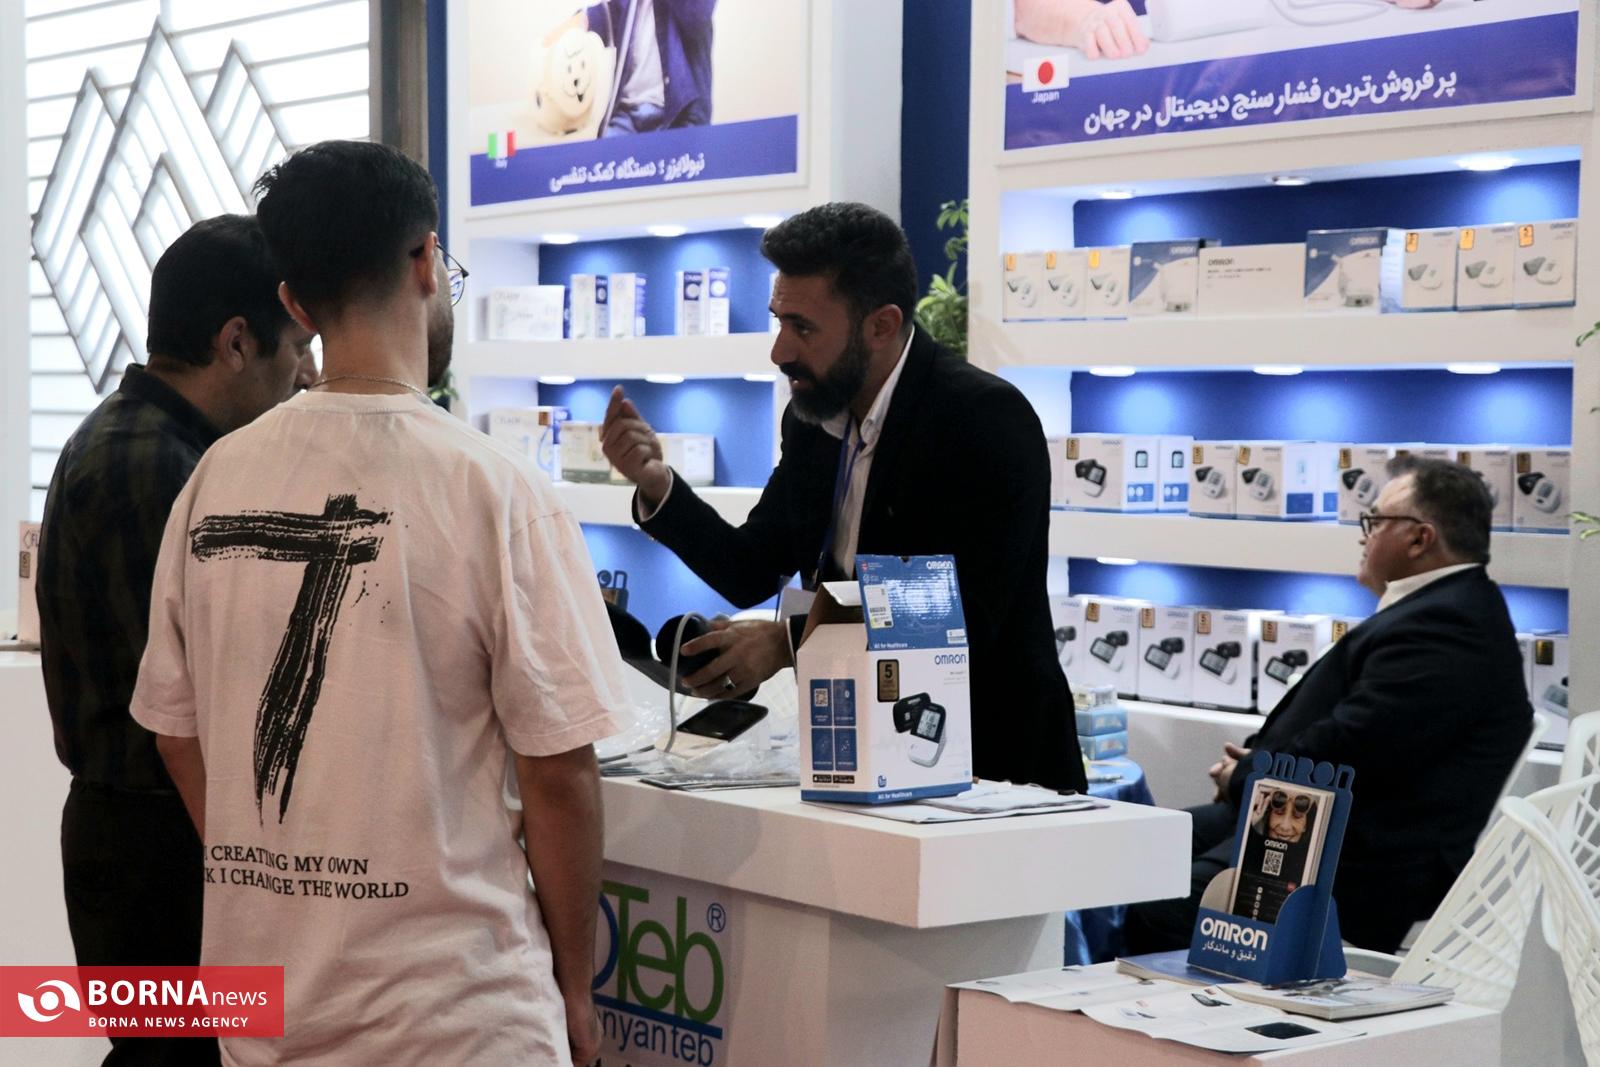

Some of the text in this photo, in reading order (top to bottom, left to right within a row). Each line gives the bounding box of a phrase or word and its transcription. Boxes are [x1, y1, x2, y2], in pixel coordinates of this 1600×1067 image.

[1031, 91, 1060, 104] Japan
[1155, 94, 1230, 127] دیجیتال
[1231, 89, 1275, 121] سنج
[1273, 77, 1321, 116] فشار
[1083, 103, 1131, 135] جهان
[1131, 103, 1153, 130] در
[884, 664, 893, 679] 5
[934, 653, 967, 666] OMRON
[1253, 750, 1356, 791] OMRON
[211, 845, 289, 872] CREATING
[294, 855, 325, 873] MY
[328, 856, 369, 876] OWN
[1264, 839, 1288, 851] OMRON
[220, 867, 227, 884] I
[230, 868, 296, 896] CHANGE
[299, 879, 333, 898] THE
[334, 881, 410, 900] WORLD
[1200, 917, 1269, 952] OMRON
[1201, 940, 1230, 954] ماندگار
[1236, 949, 1258, 962] دقیق
[597, 1009, 714, 1067] nyanteb
